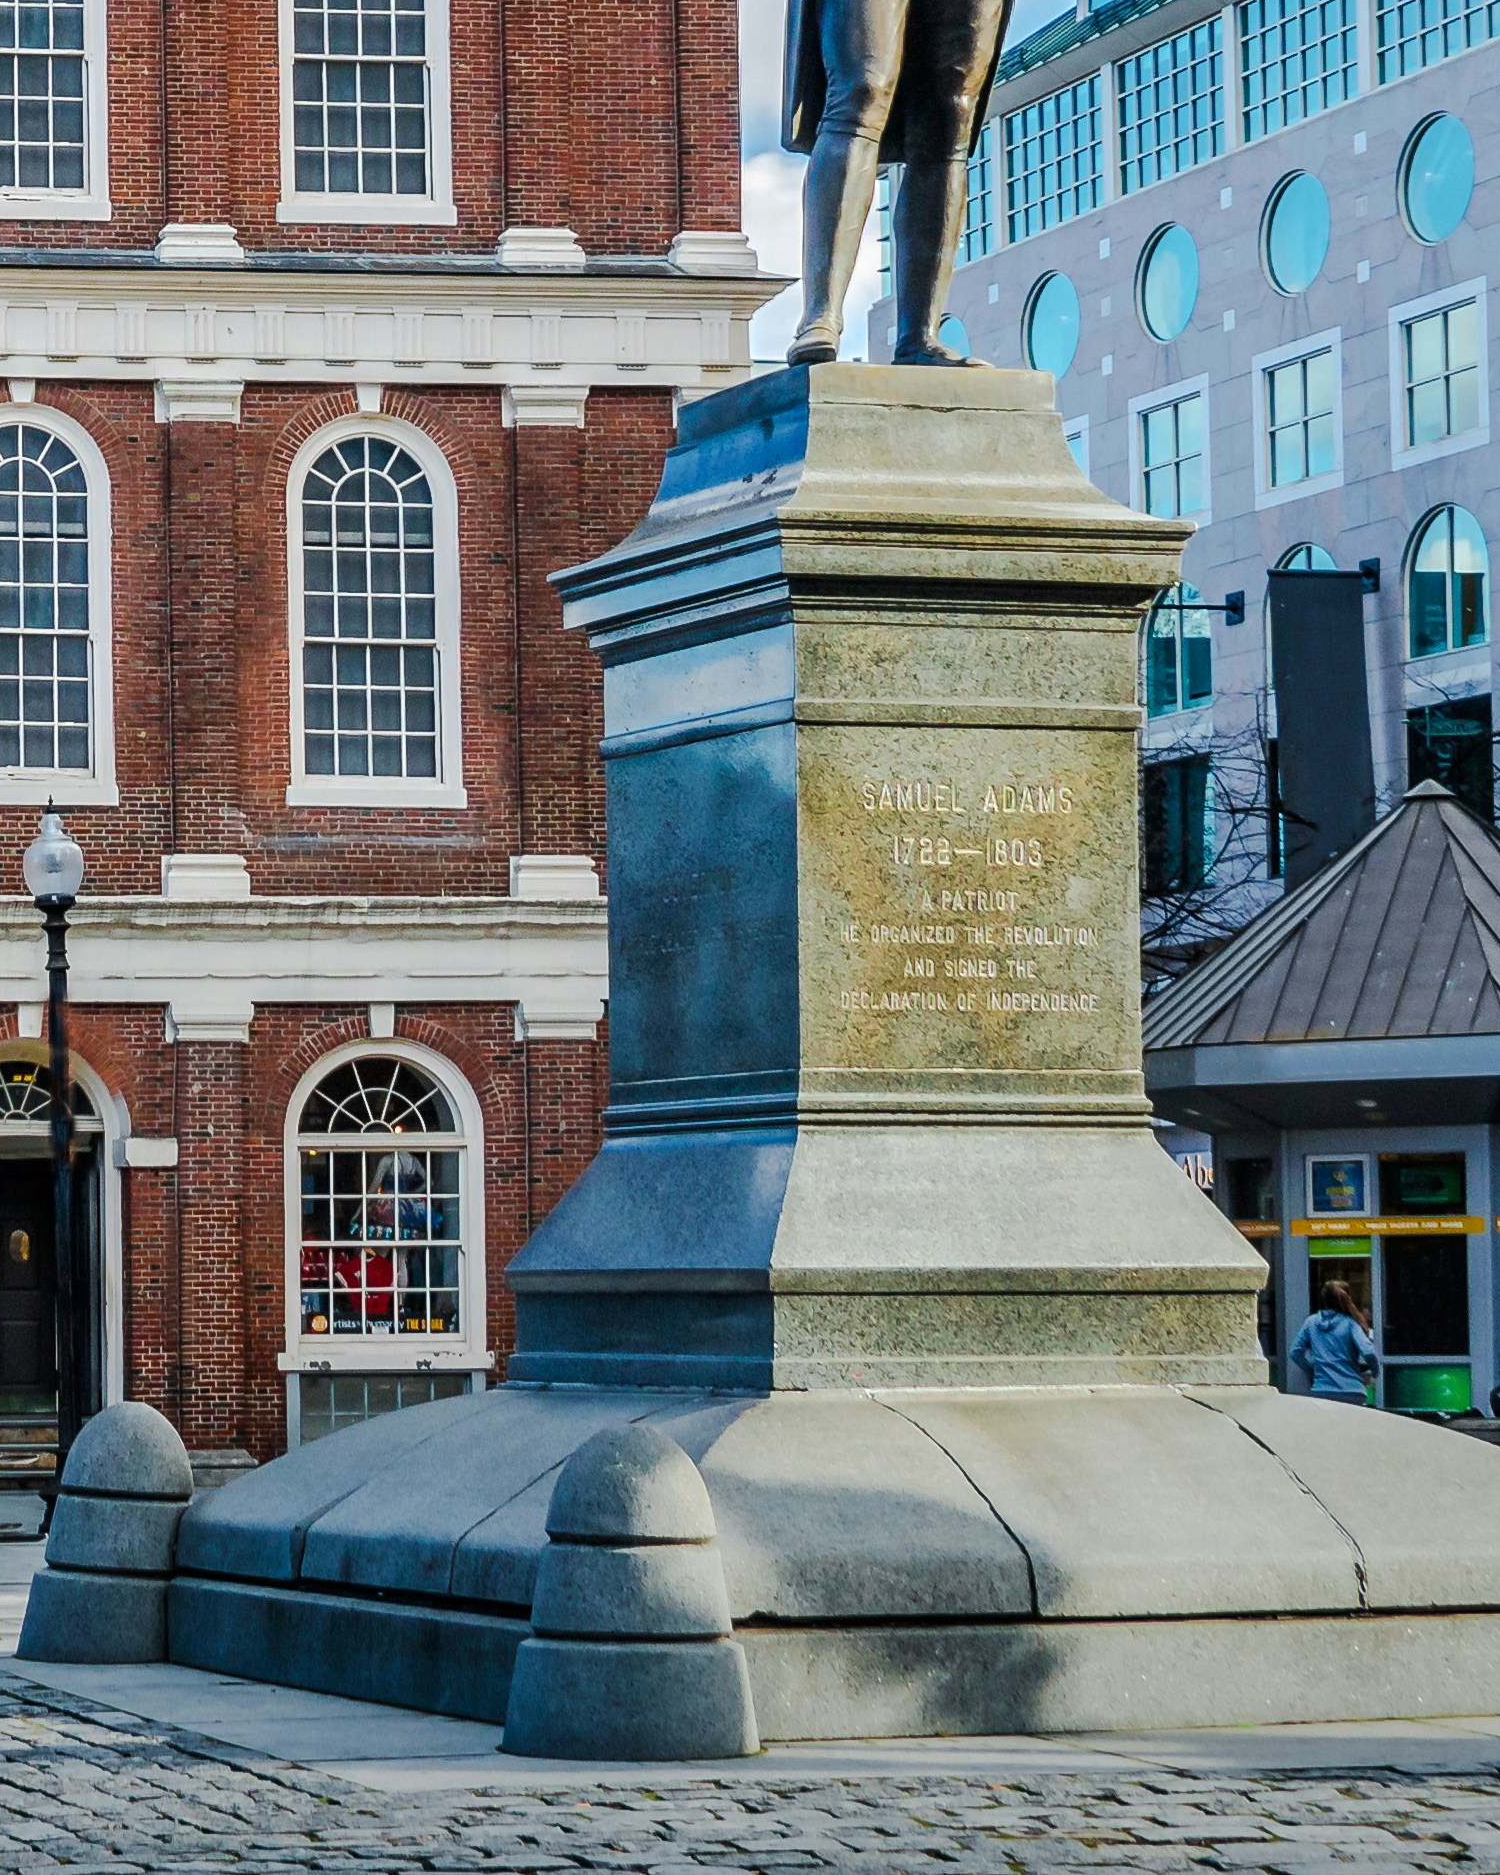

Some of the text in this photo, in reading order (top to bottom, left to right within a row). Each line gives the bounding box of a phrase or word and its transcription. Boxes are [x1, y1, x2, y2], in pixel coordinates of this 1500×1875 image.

[861, 782, 1073, 814] SAMUEL ADAMS
[921, 889, 1019, 912] A PATRIOT
[840, 924, 1099, 945] HE ORGANIZED THE REVOLUTION
[903, 957, 1038, 978] AND SIGNED THE
[840, 990, 1100, 1012] DECLARATION OF INDEPENDENCE
